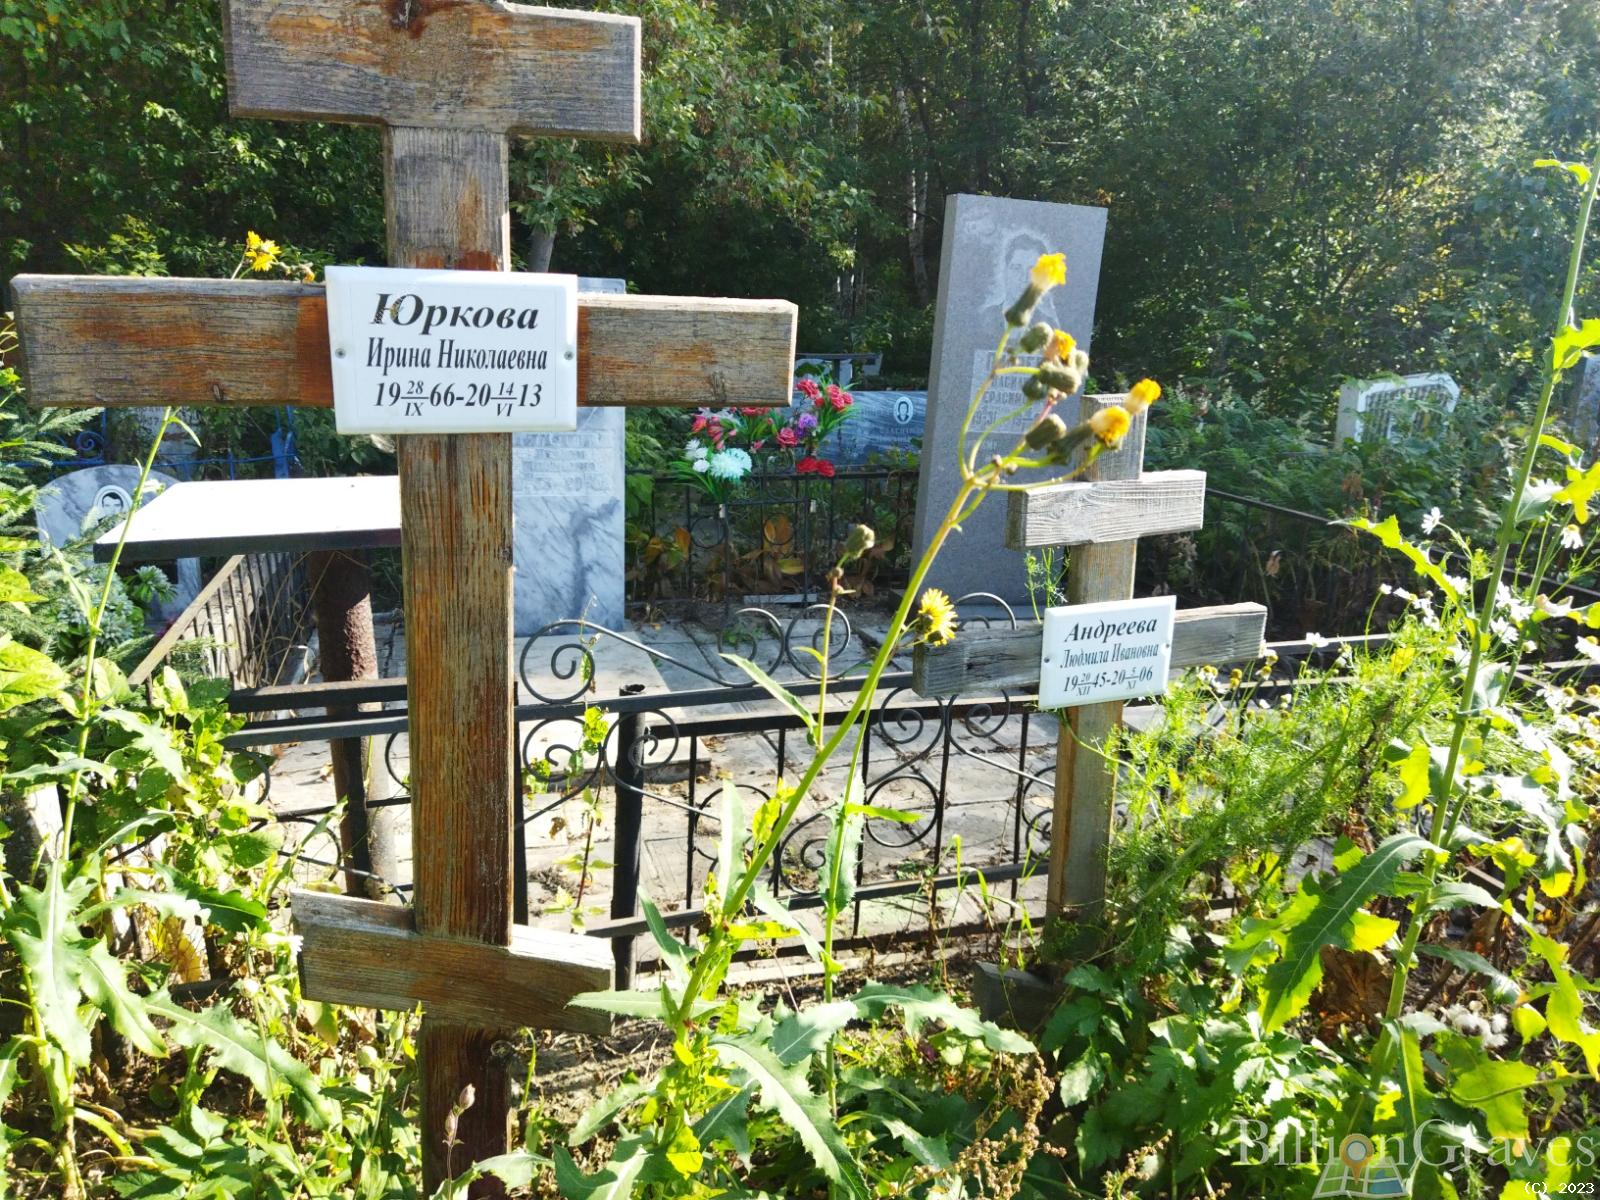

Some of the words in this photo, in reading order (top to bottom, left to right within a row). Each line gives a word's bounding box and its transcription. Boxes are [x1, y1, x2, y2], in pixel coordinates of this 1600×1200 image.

[369, 293, 540, 336] Юркова
[366, 336, 431, 377] Ирина
[437, 338, 548, 371] Николаевна
[1064, 619, 1158, 644] Андреева
[1060, 648, 1110, 669] Людмила
[1112, 642, 1160, 663] Ивановна
